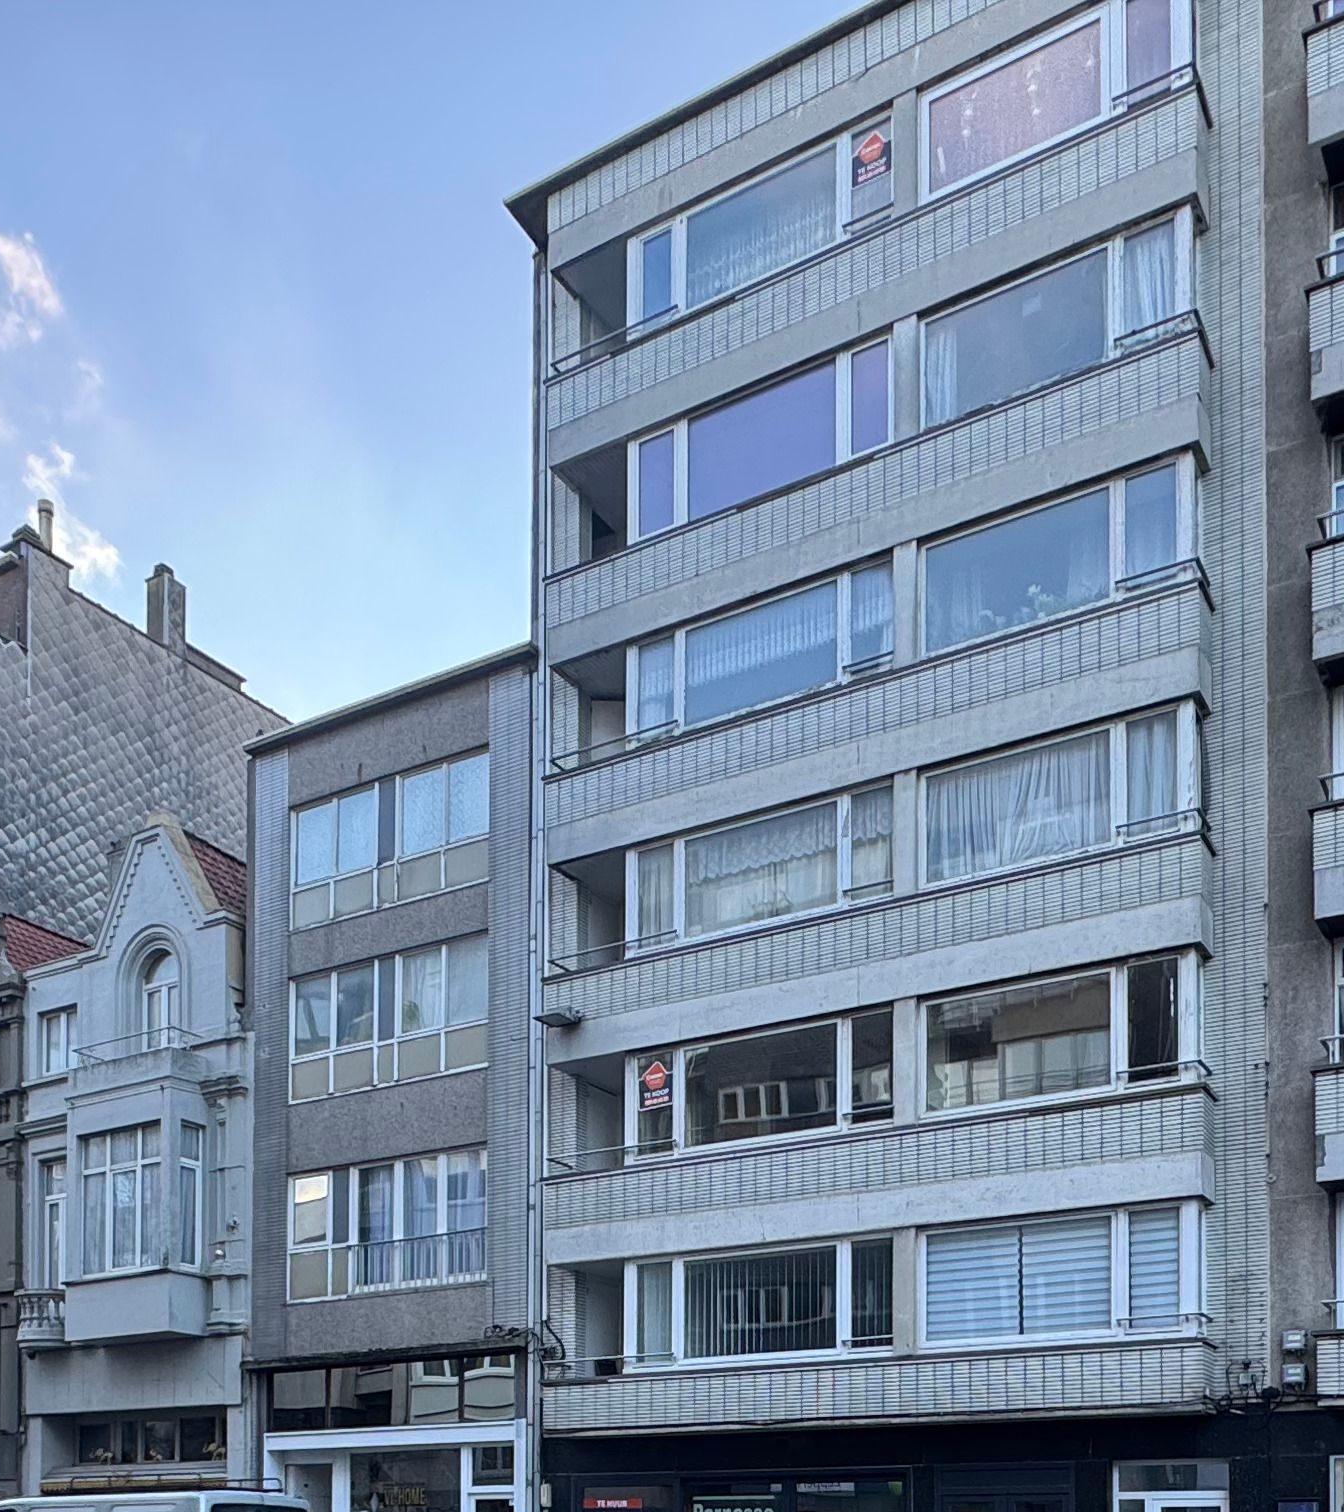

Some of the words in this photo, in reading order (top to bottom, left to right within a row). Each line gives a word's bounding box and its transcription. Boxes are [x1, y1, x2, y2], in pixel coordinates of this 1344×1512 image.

[652, 1088, 670, 1097] KOOP
[399, 1487, 426, 1505] HOME
[596, 1500, 606, 1508] TE
